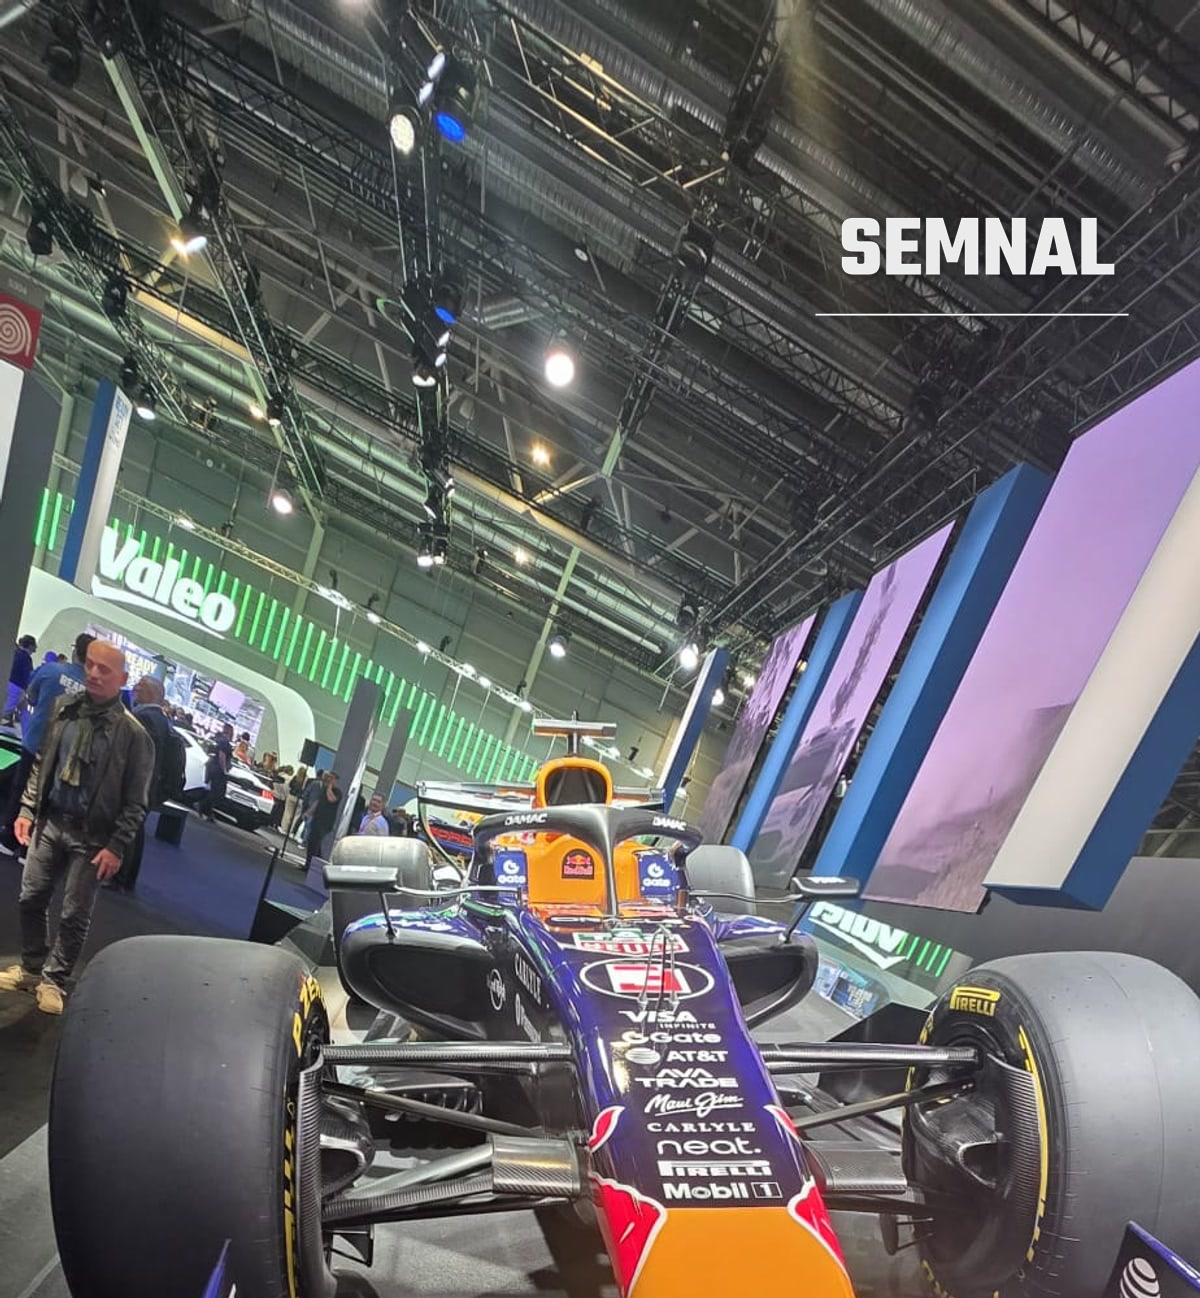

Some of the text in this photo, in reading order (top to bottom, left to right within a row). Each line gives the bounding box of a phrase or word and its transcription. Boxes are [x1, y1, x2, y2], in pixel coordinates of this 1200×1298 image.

[100, 525, 236, 632] Valeo
[504, 813, 547, 826] DAMAC
[652, 816, 687, 831] DAMAC
[949, 986, 1001, 1017] PIRELLI
[619, 1010, 697, 1023] VISA
[650, 1032, 722, 1043] Gate
[666, 1050, 728, 1062] AT&T
[656, 1068, 713, 1078] AVA
[635, 1078, 739, 1088] TRADE
[644, 1092, 744, 1118] Maui Jim
[647, 1122, 755, 1132] CARLYLE
[657, 1137, 762, 1155] neat.
[657, 1160, 773, 1177] PIRELLI
[662, 1182, 749, 1199] Mobil
